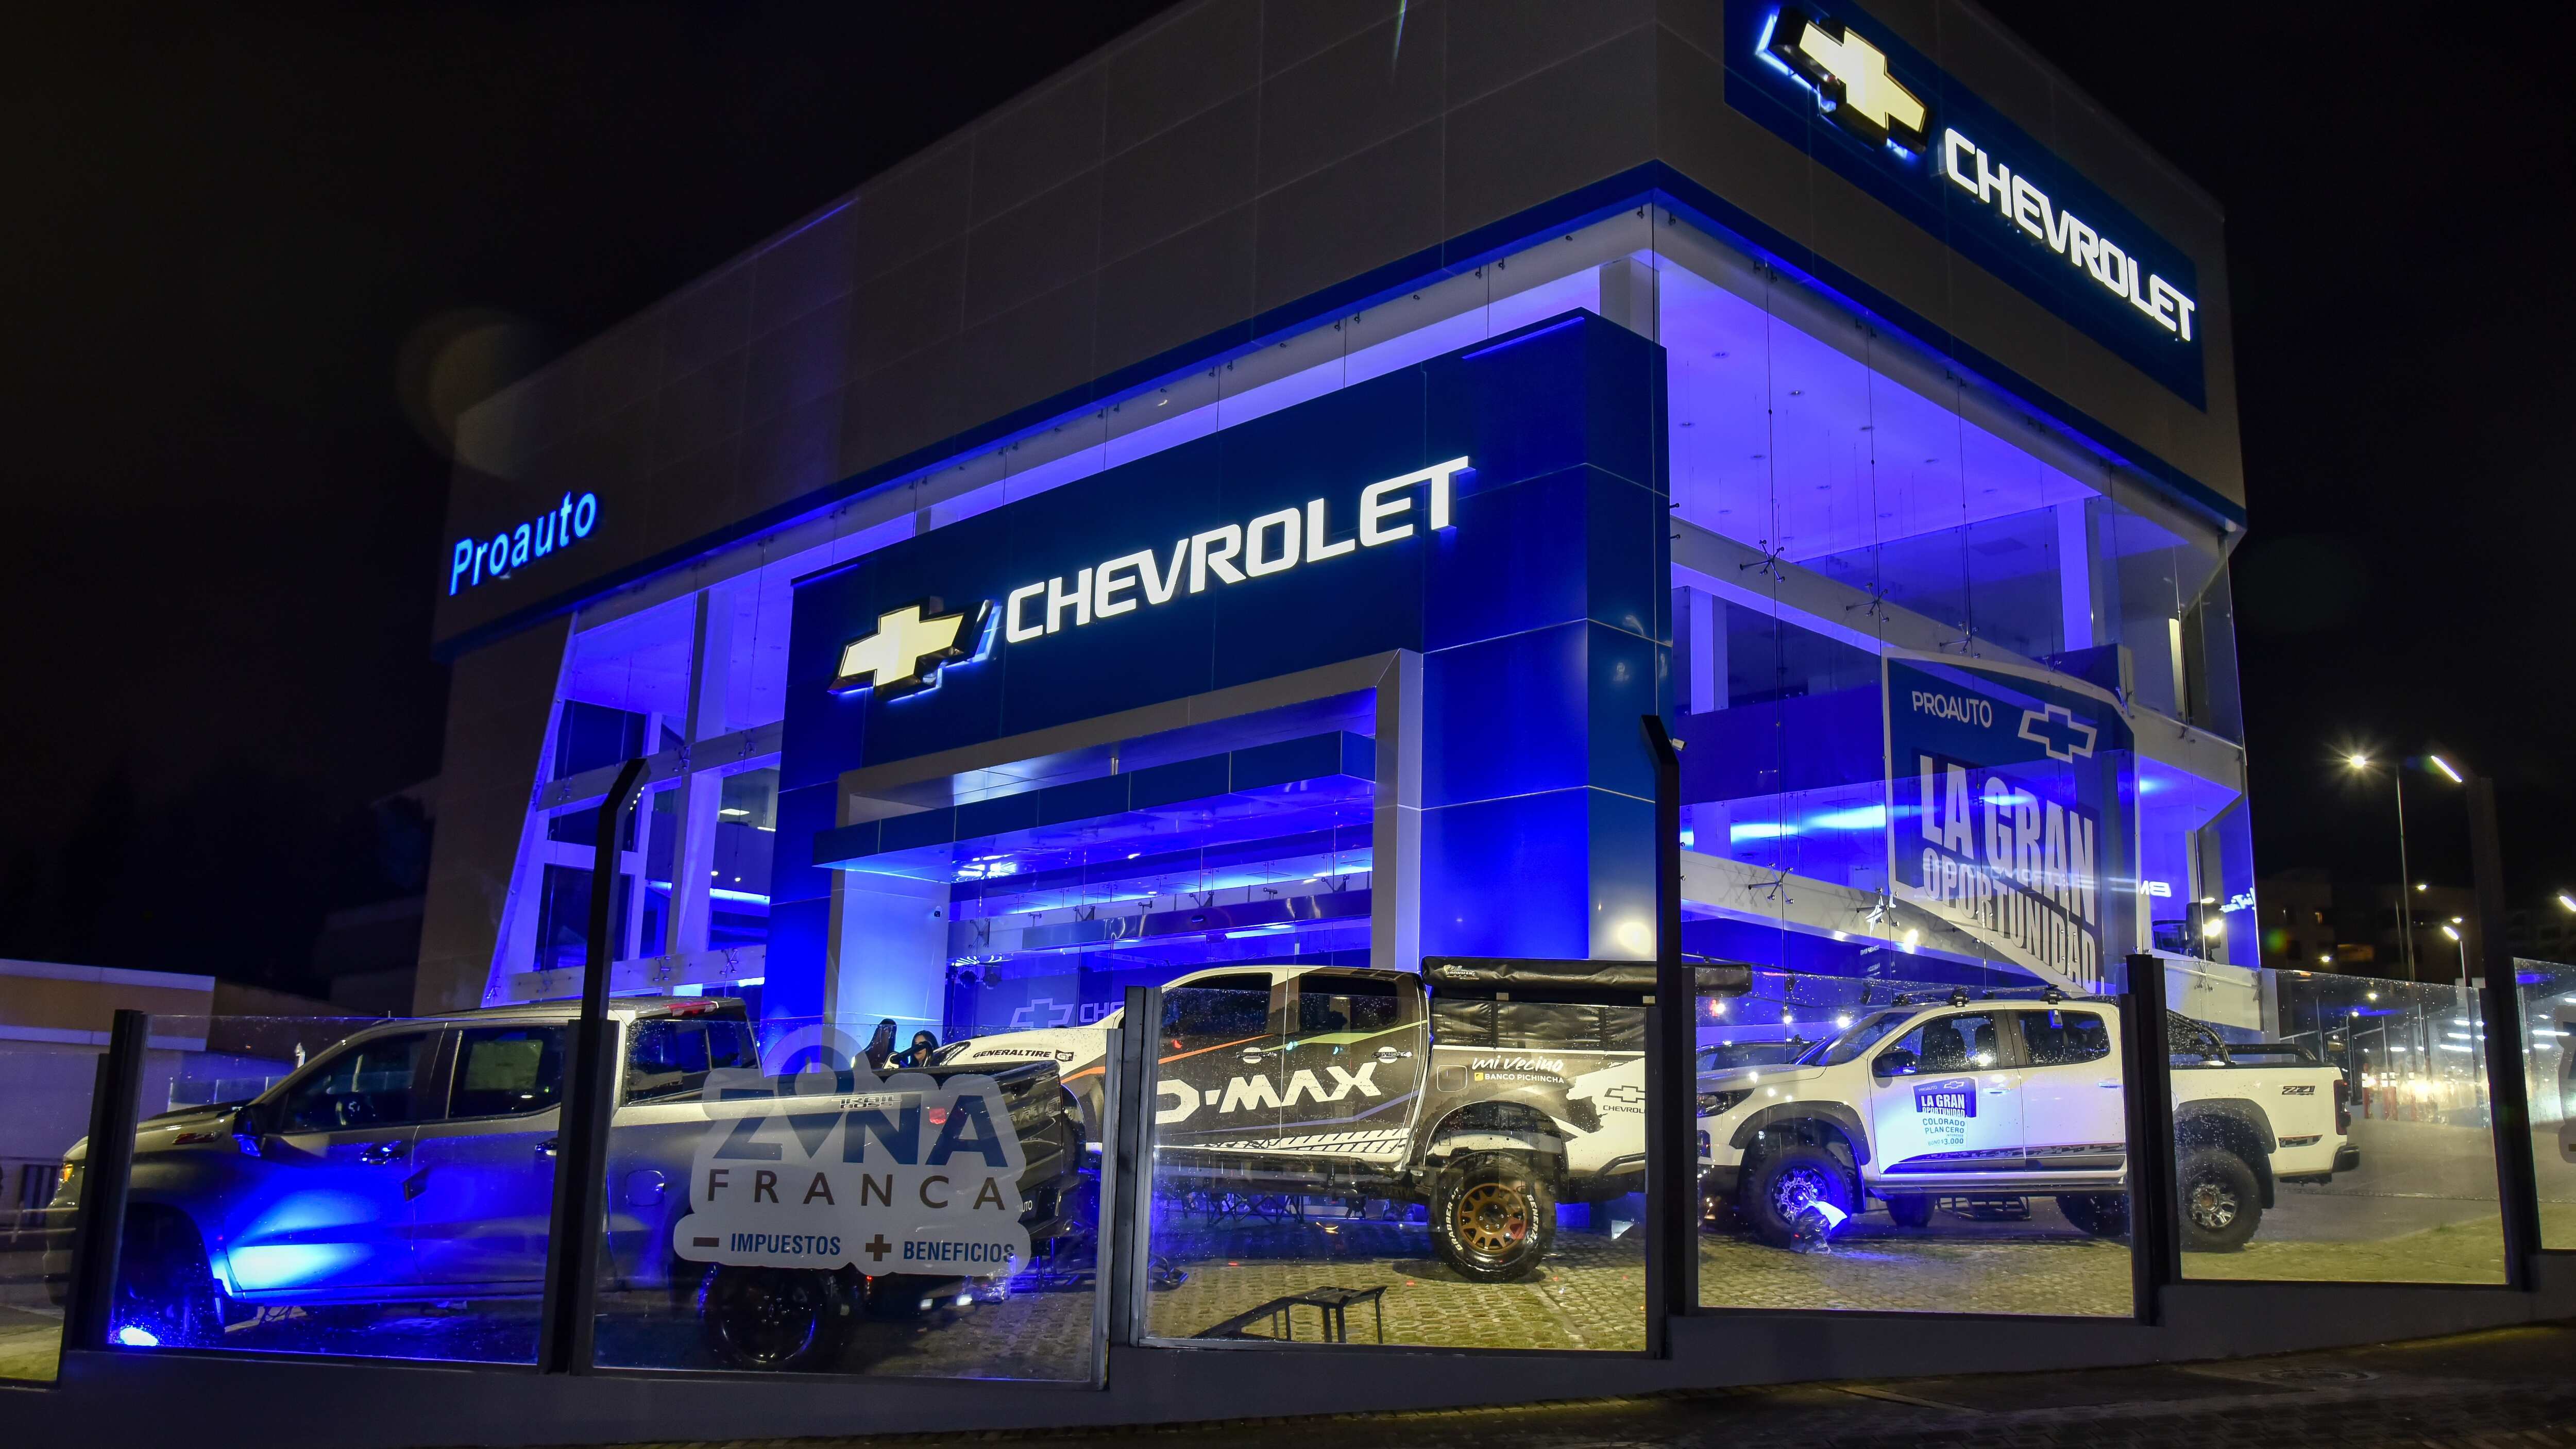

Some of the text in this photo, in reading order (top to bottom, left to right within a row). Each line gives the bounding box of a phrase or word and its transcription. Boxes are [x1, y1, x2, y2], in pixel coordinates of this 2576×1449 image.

[1944, 128, 2195, 342] CHEVROLET
[449, 491, 598, 597] Proauto
[1006, 456, 1469, 644] CHEVROLET
[1912, 690, 1992, 728] PROAUTO
[1920, 754, 2096, 926] LA GRAN
[1517, 1074, 1564, 1084] PICHINCHA
[1603, 1104, 1645, 1114] CHEVROL
[1921, 1094, 1965, 1109] LA GRAN
[1922, 1118, 1965, 1126] COLORADO
[707, 1169, 1006, 1211] FRANCA
[1445, 1201, 1464, 1252] GRABBER
[1526, 1194, 1539, 1245] GENERAL
[731, 1232, 841, 1256] IMPUESTOS
[903, 1240, 1015, 1263] BENEFICIOS
